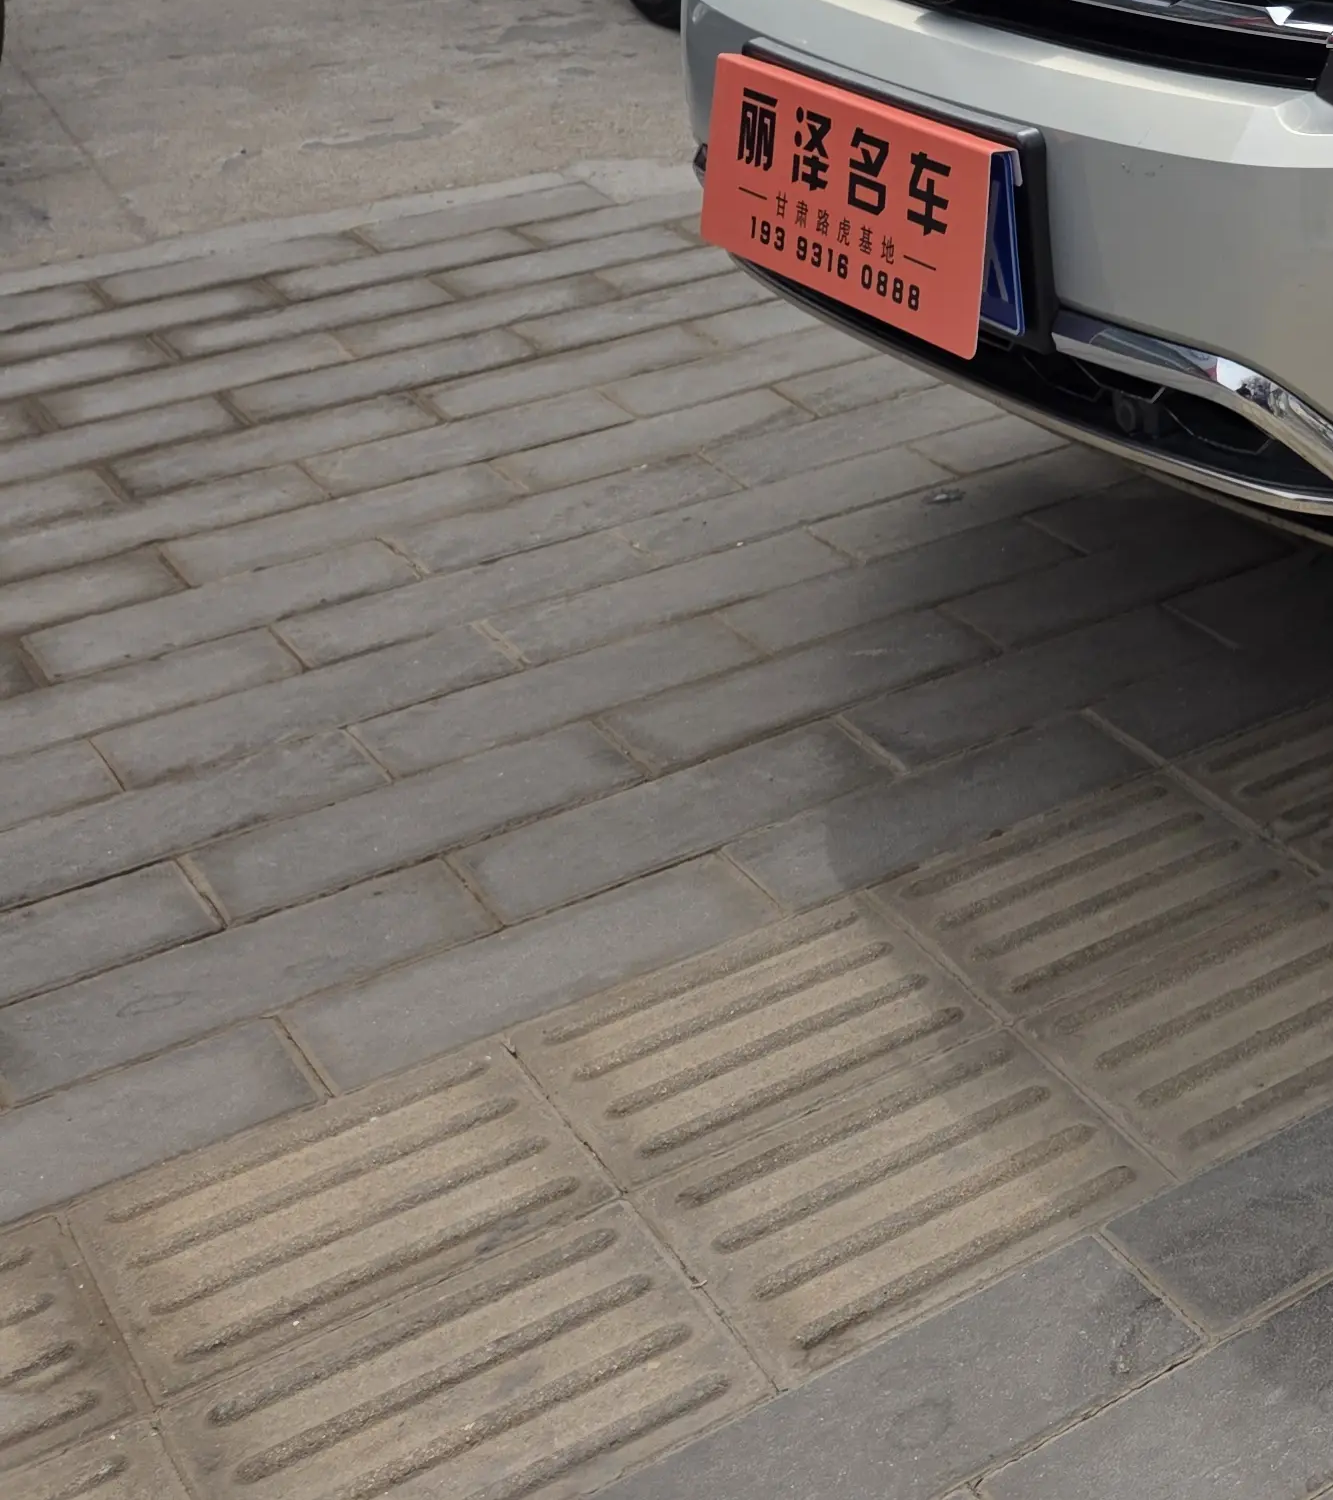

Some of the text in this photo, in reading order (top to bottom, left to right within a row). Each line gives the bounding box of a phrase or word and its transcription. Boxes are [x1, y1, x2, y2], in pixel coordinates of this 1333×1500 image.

[736, 87, 952, 237] 丽泽名车
[751, 216, 920, 312] 193 9316 0888
[775, 191, 895, 266] 甘肃路虎基地
